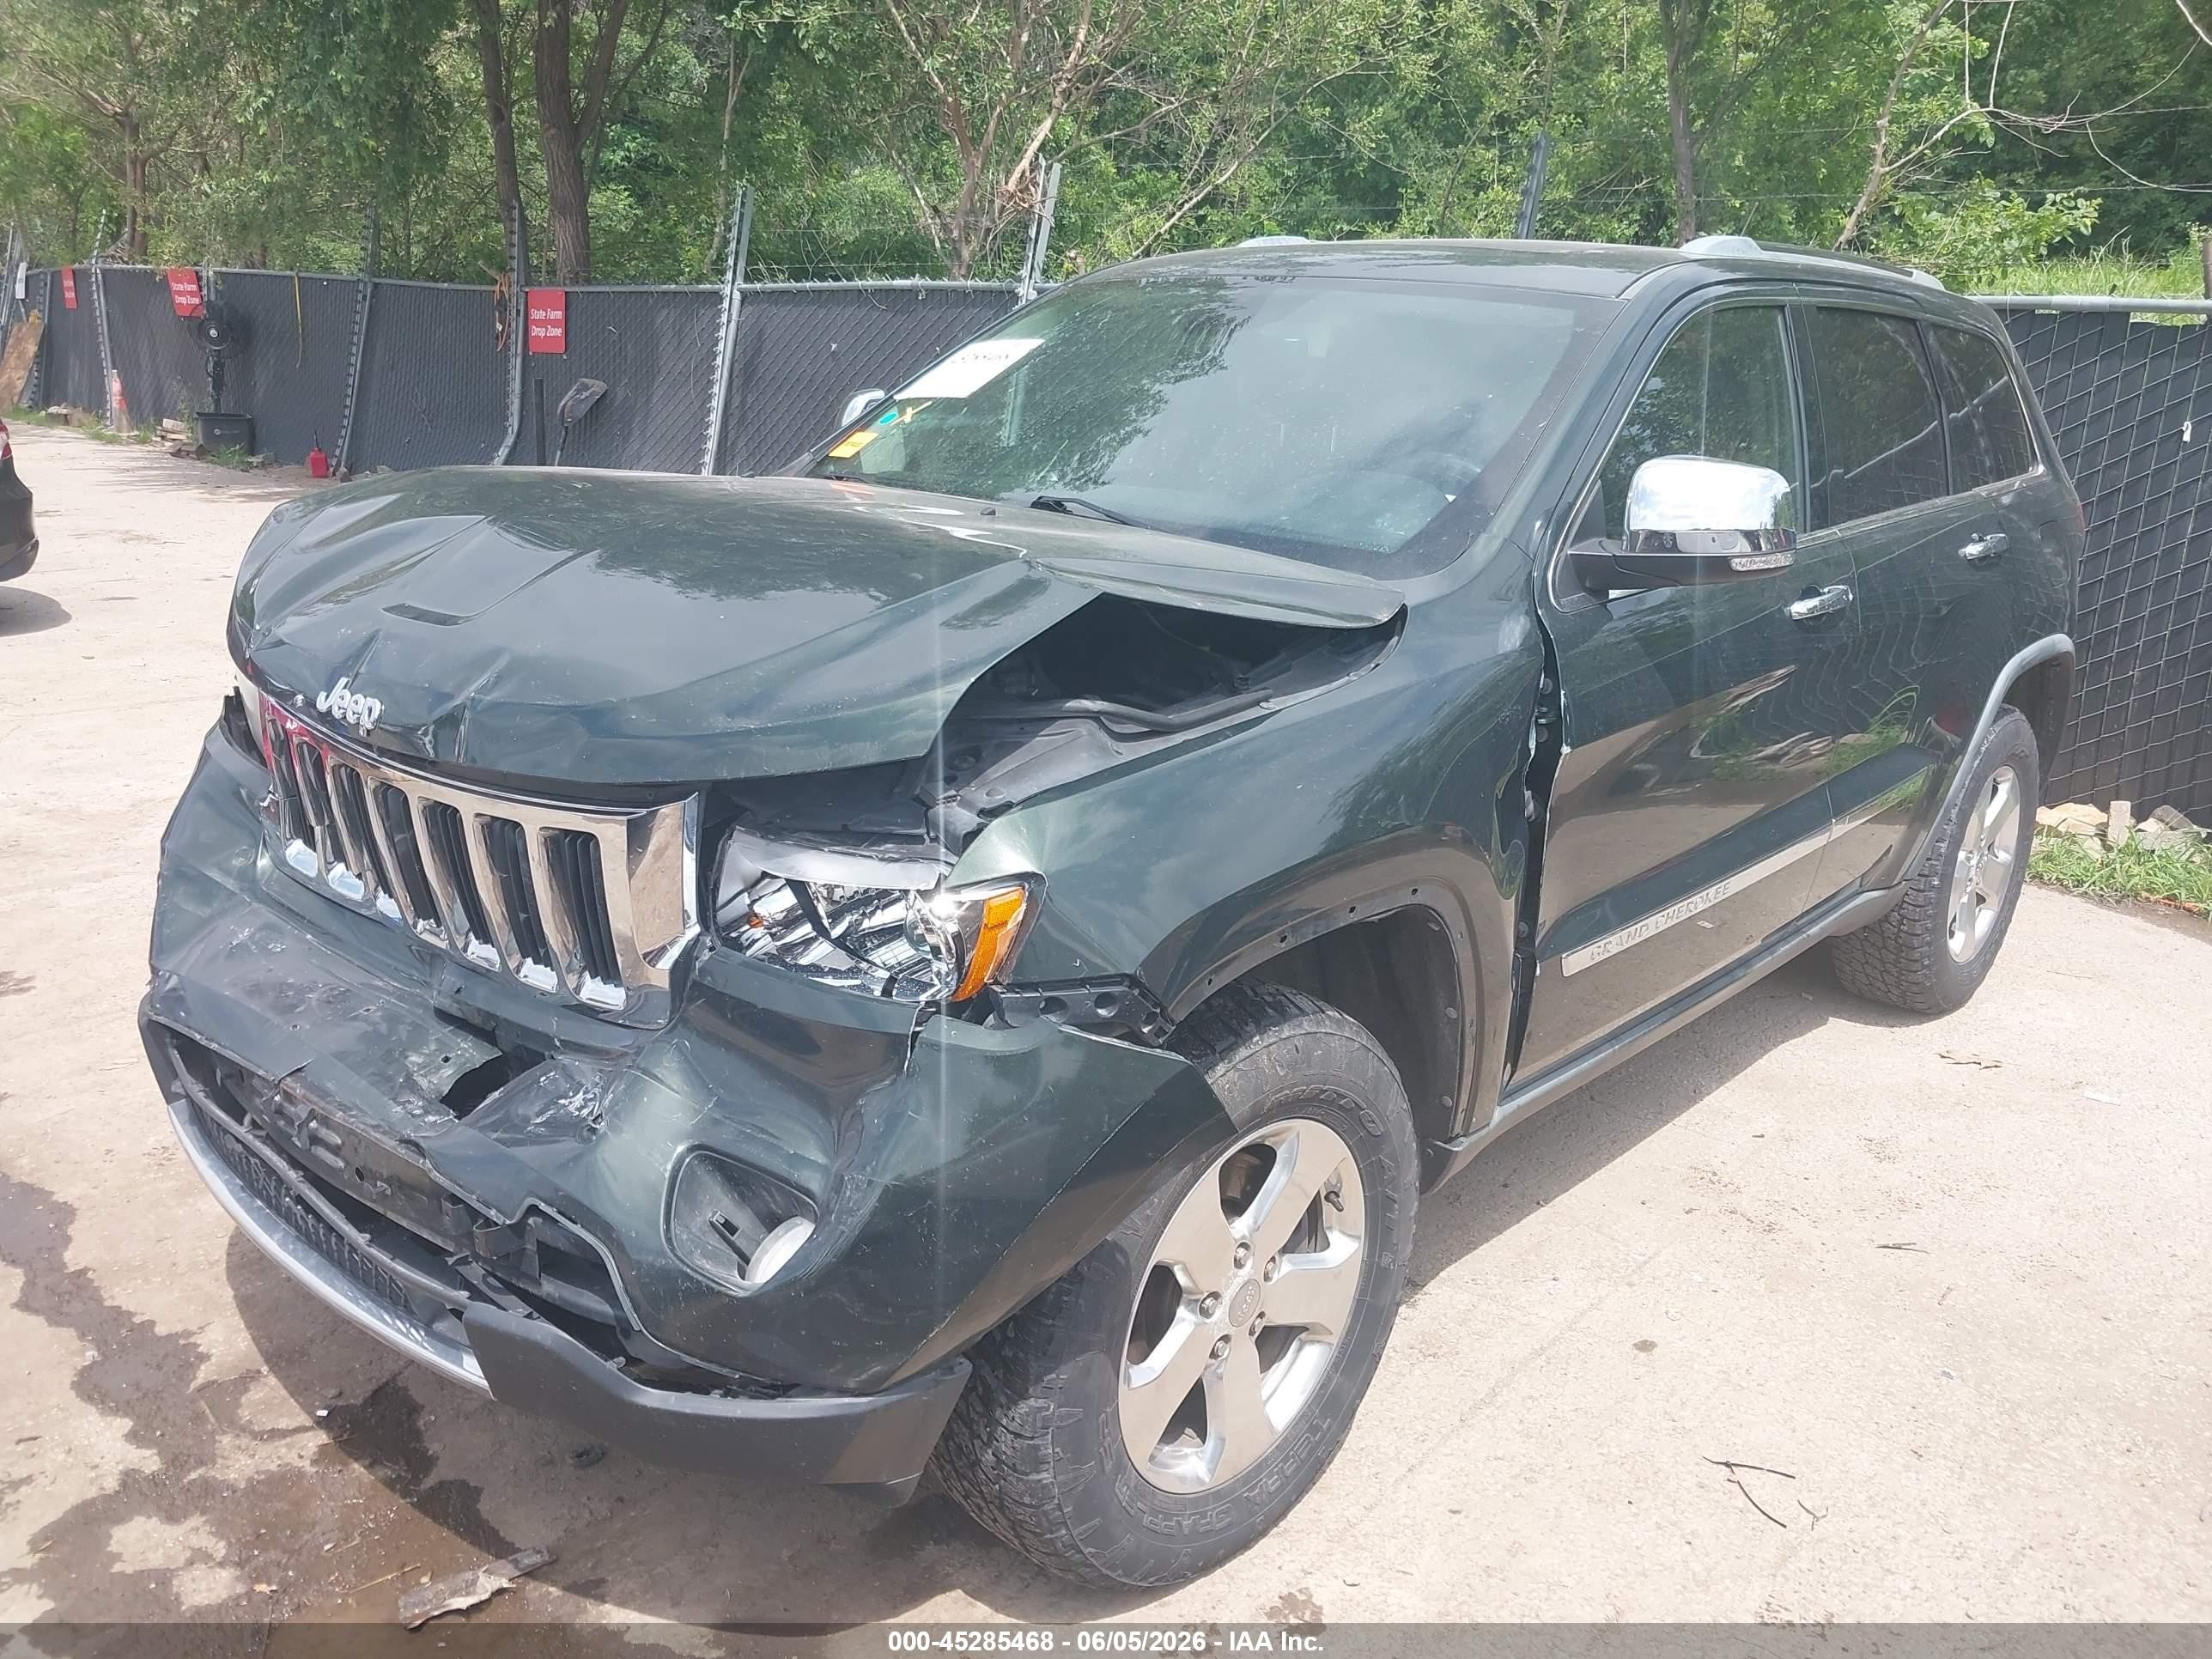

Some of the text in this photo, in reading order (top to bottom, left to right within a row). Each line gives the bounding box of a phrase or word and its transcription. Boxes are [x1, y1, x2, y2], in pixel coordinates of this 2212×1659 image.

[530, 308, 562, 319] State Farm
[531, 325, 562, 339] Drop Zone
[316, 677, 384, 737] Jeep
[1590, 881, 1732, 961] GRAND CHEROKEE
[1243, 1419, 1331, 1505] TERRA
